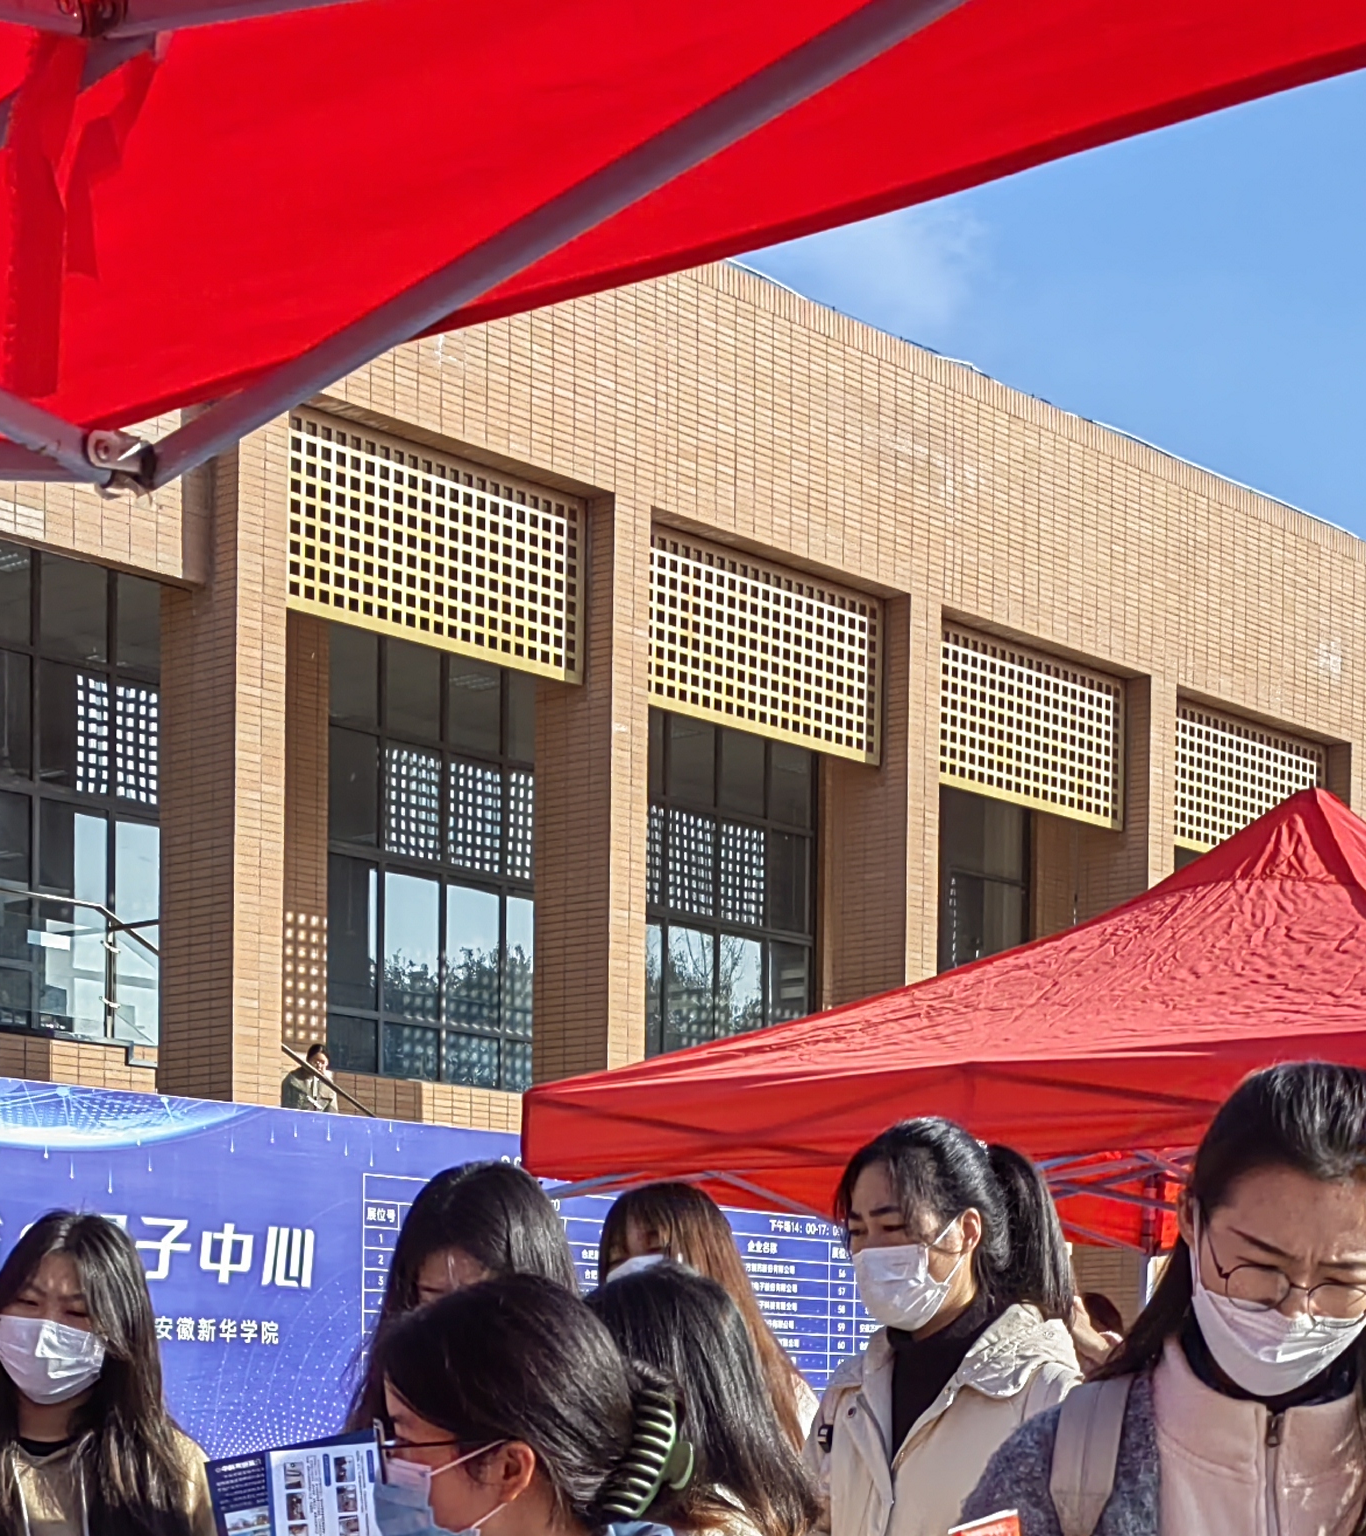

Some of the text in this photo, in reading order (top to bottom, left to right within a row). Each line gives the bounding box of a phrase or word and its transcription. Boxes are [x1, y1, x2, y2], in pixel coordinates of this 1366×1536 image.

[366, 1207, 396, 1224] 展位号
[378, 1233, 384, 1244] 1
[747, 1240, 778, 1255] 企业名称
[377, 1255, 385, 1266] 2
[838, 1269, 847, 1278] 56
[377, 1275, 384, 1286] 3
[838, 1287, 846, 1296] 57
[837, 1305, 846, 1314] 58
[155, 1316, 279, 1346] 安徽新华学院
[837, 1323, 846, 1332] 59
[837, 1341, 846, 1350] 60
